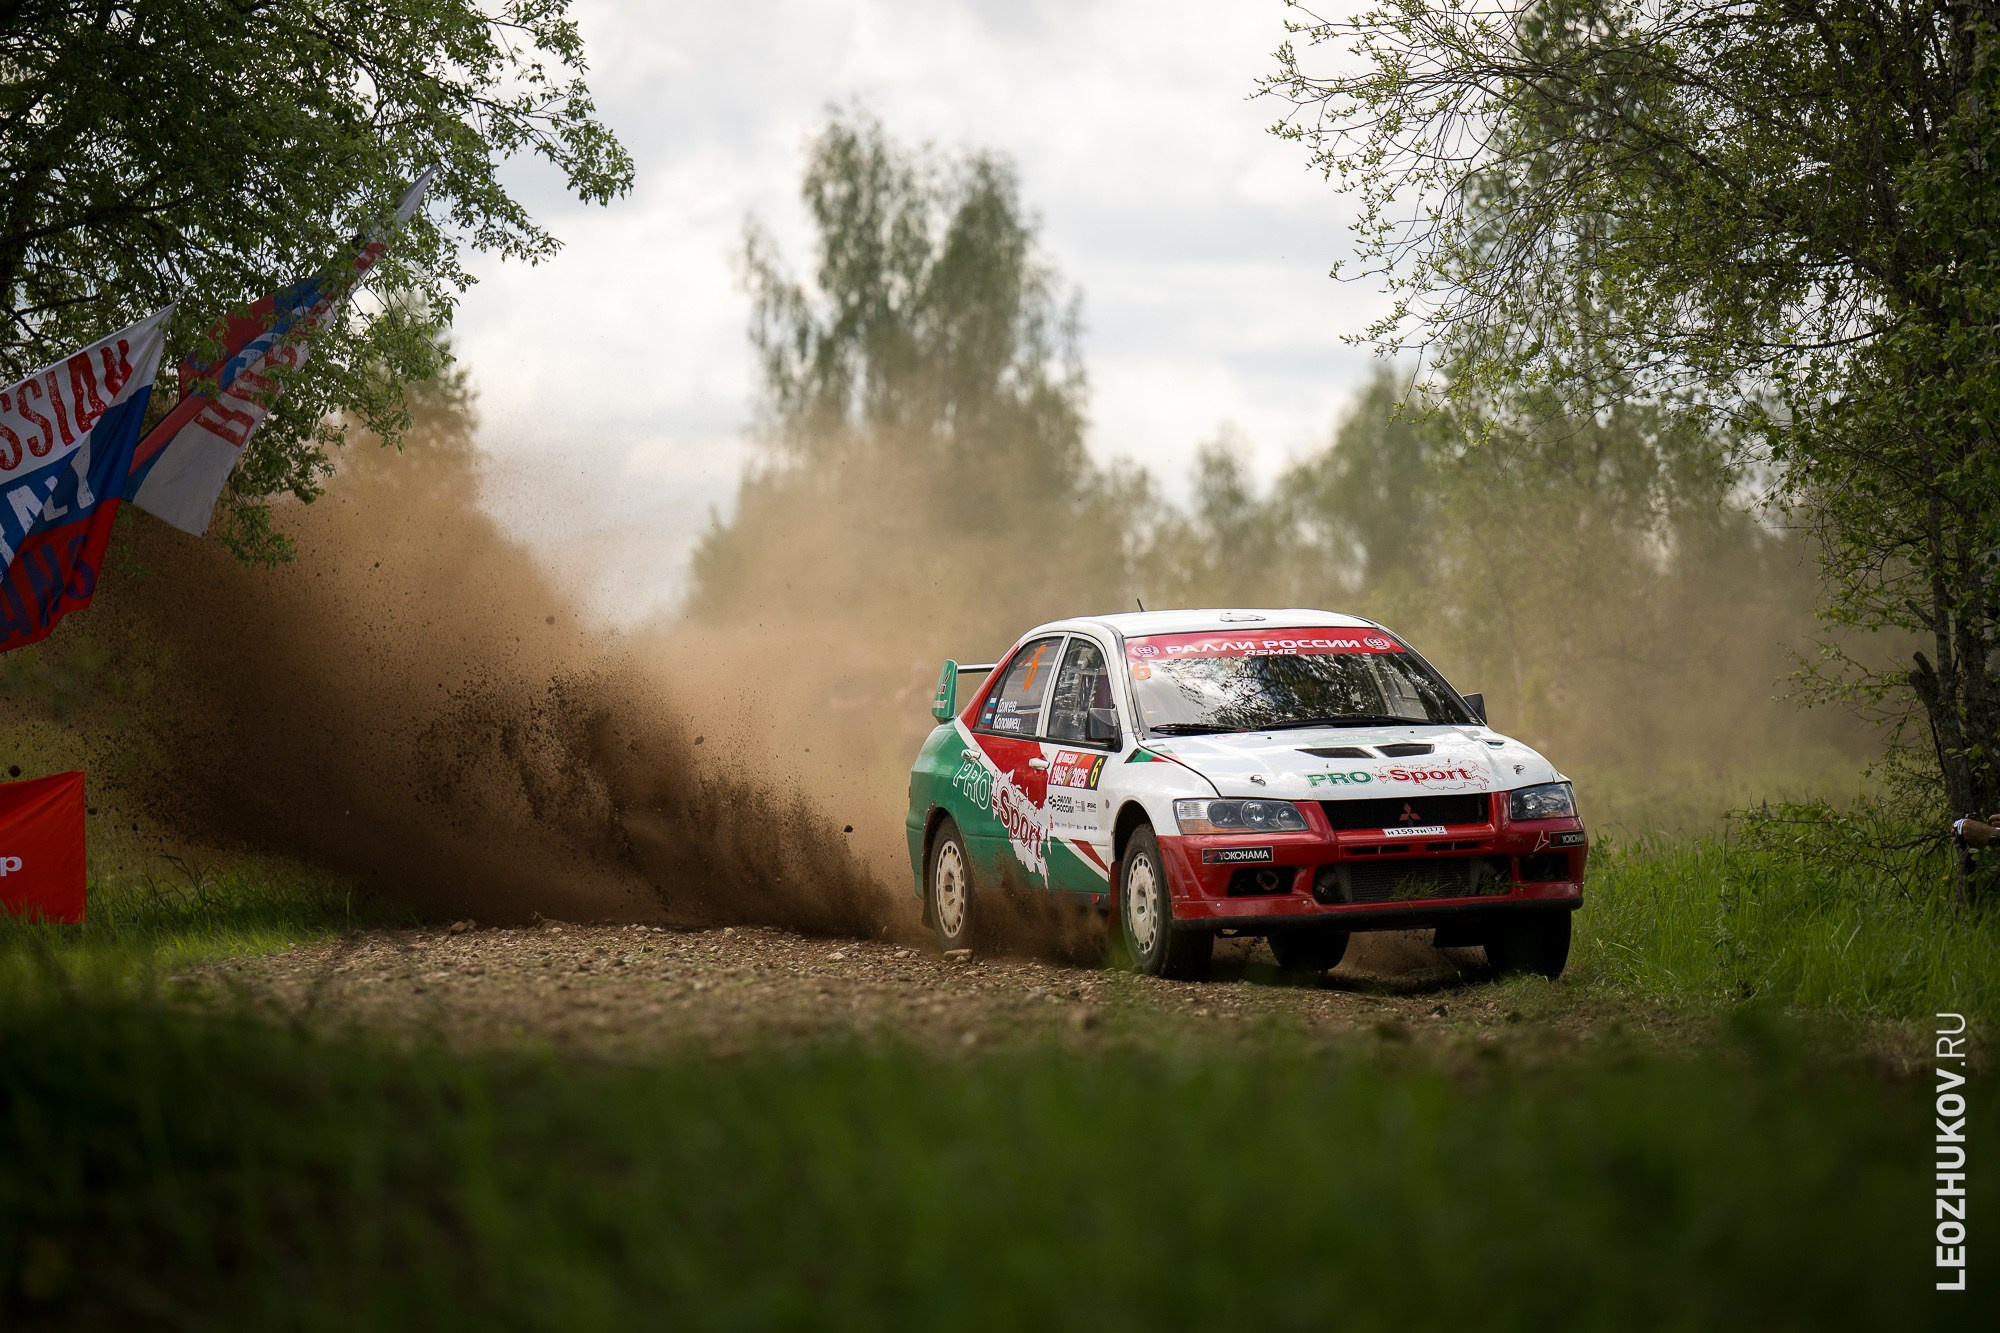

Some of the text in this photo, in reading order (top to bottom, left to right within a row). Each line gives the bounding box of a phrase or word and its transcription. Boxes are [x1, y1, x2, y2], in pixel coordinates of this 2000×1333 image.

[1165, 641, 1257, 655] РАЛЛИ
[1262, 639, 1362, 649] РОССИИ
[1023, 643, 1047, 691] 6
[1132, 661, 1152, 681] 6
[1069, 767, 1089, 788] 2025
[1089, 757, 1103, 788] 6
[1218, 850, 1269, 861] YOKOHAMA
